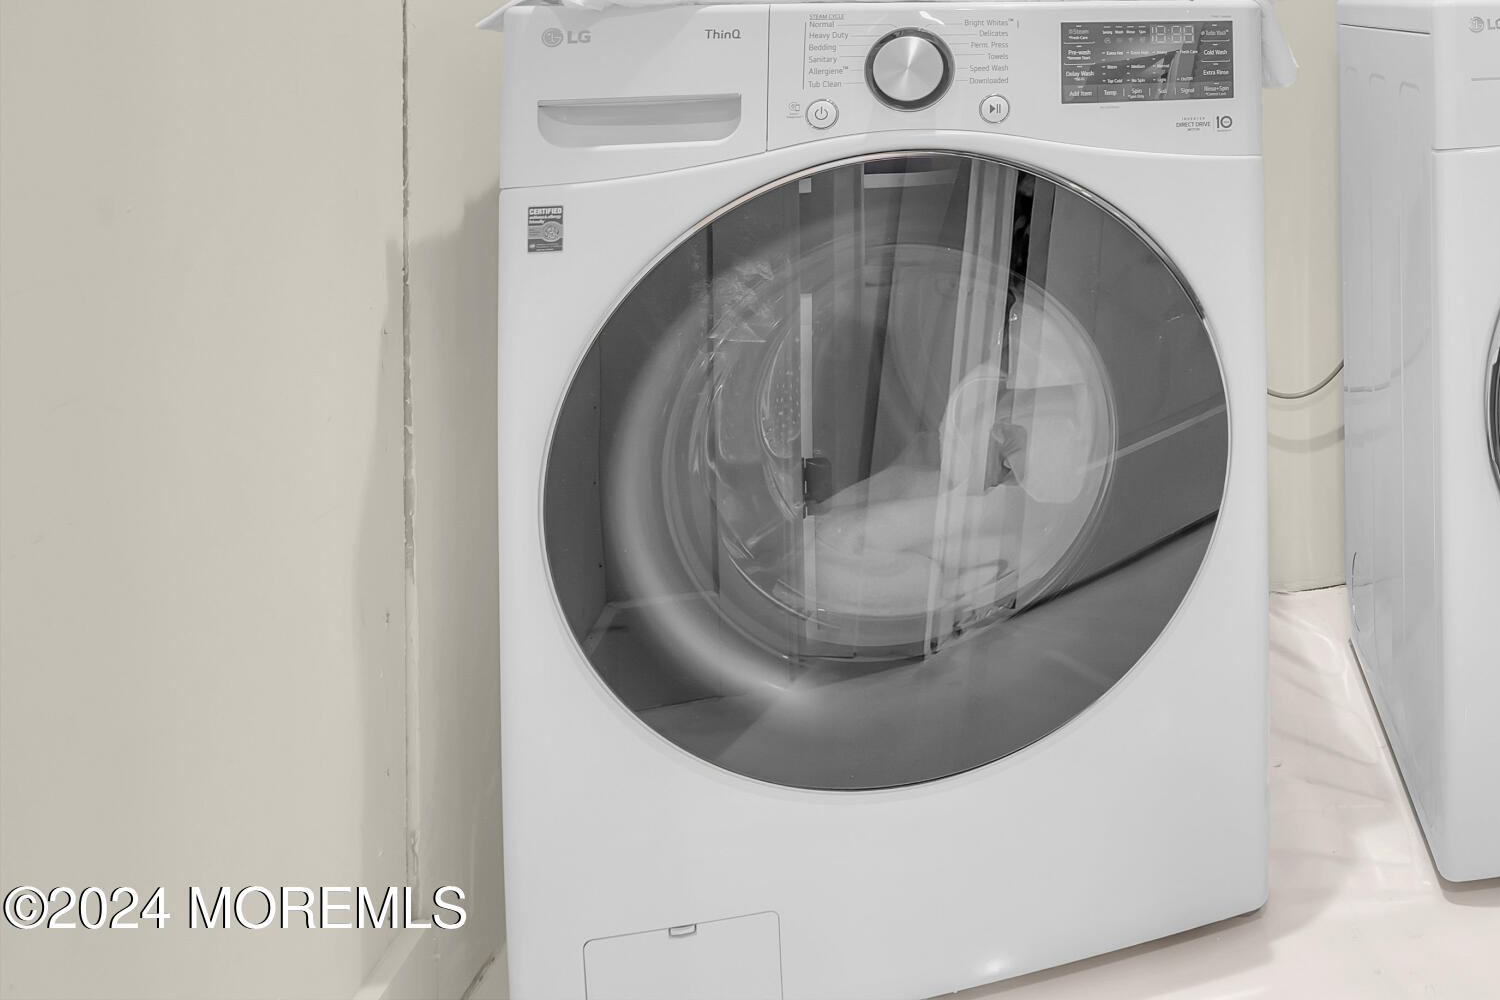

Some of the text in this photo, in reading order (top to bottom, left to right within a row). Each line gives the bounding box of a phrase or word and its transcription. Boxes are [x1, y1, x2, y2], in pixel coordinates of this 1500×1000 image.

[964, 19, 984, 27] Bright
[567, 30, 592, 44] LG
[704, 28, 742, 40] ThinQ
[809, 31, 849, 40] Heavy Duty
[979, 29, 1009, 37] Delicates
[808, 43, 837, 53] Bedding
[808, 56, 838, 64] Sanitary
[969, 64, 1009, 73] Speed Wash
[969, 77, 1009, 85] Downloaded
[529, 207, 563, 215] CERTIFIED
